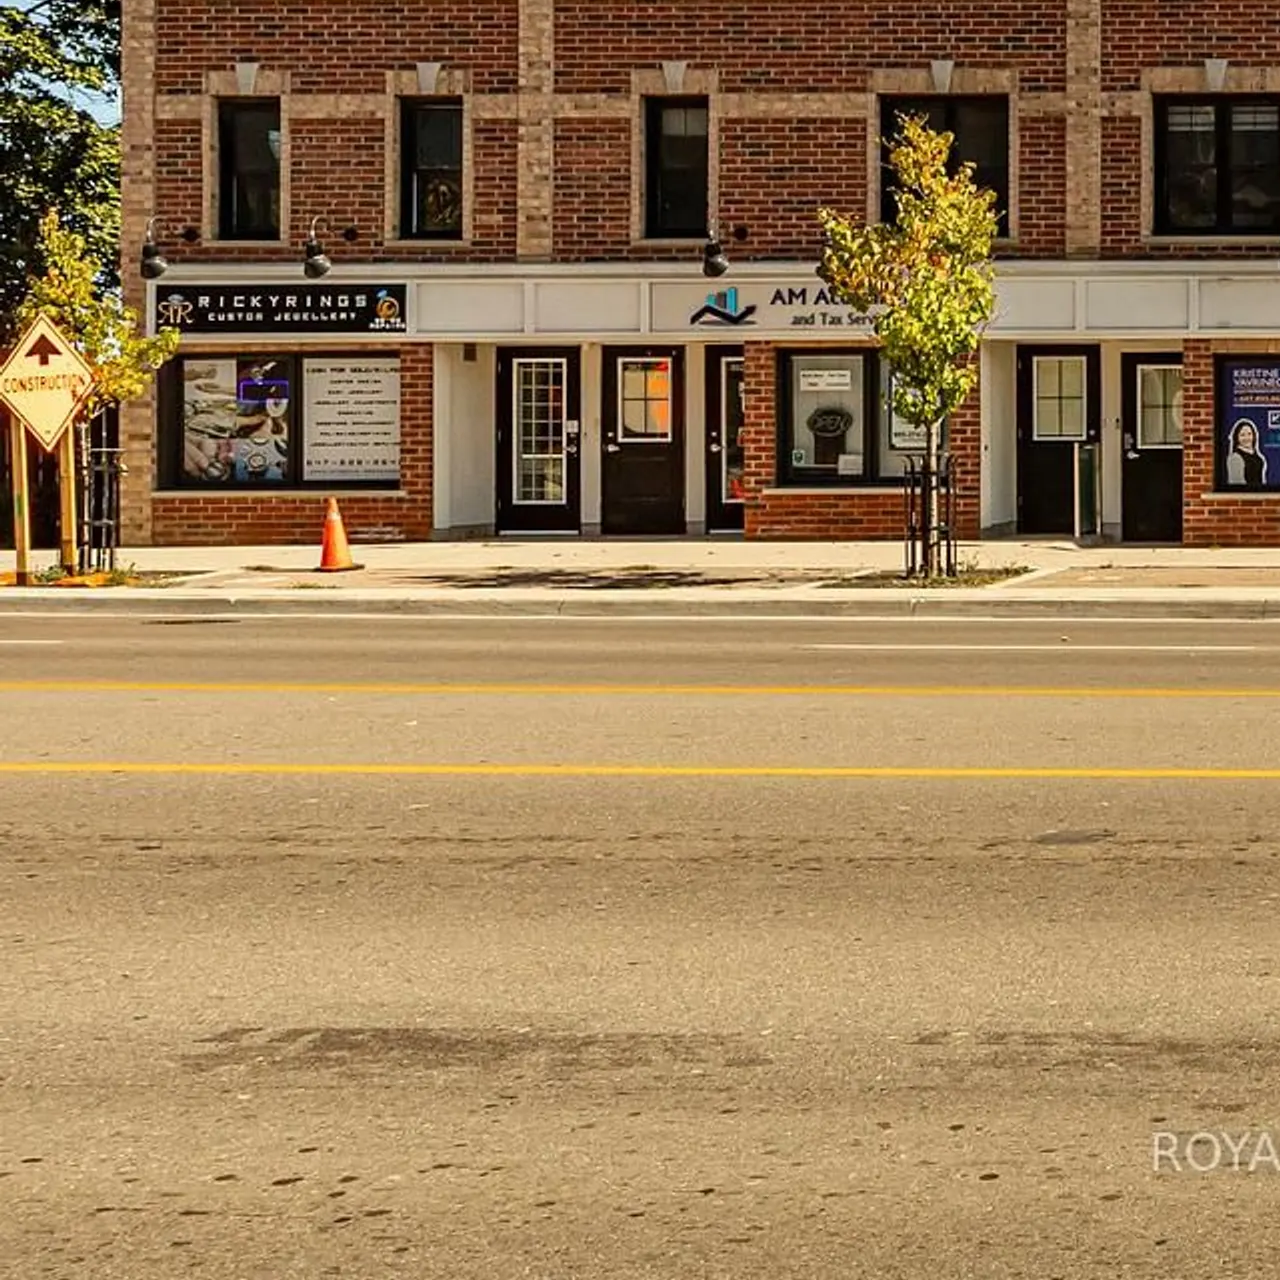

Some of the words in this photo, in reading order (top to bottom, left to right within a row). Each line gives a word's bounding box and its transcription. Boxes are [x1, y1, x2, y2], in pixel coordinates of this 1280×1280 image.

[198, 295, 368, 308] RICKYRINGS
[770, 287, 807, 305] AM
[208, 312, 264, 322] CUSTOM
[273, 312, 357, 322] JEWELLERY
[791, 312, 816, 326] and
[820, 312, 843, 326] Tax
